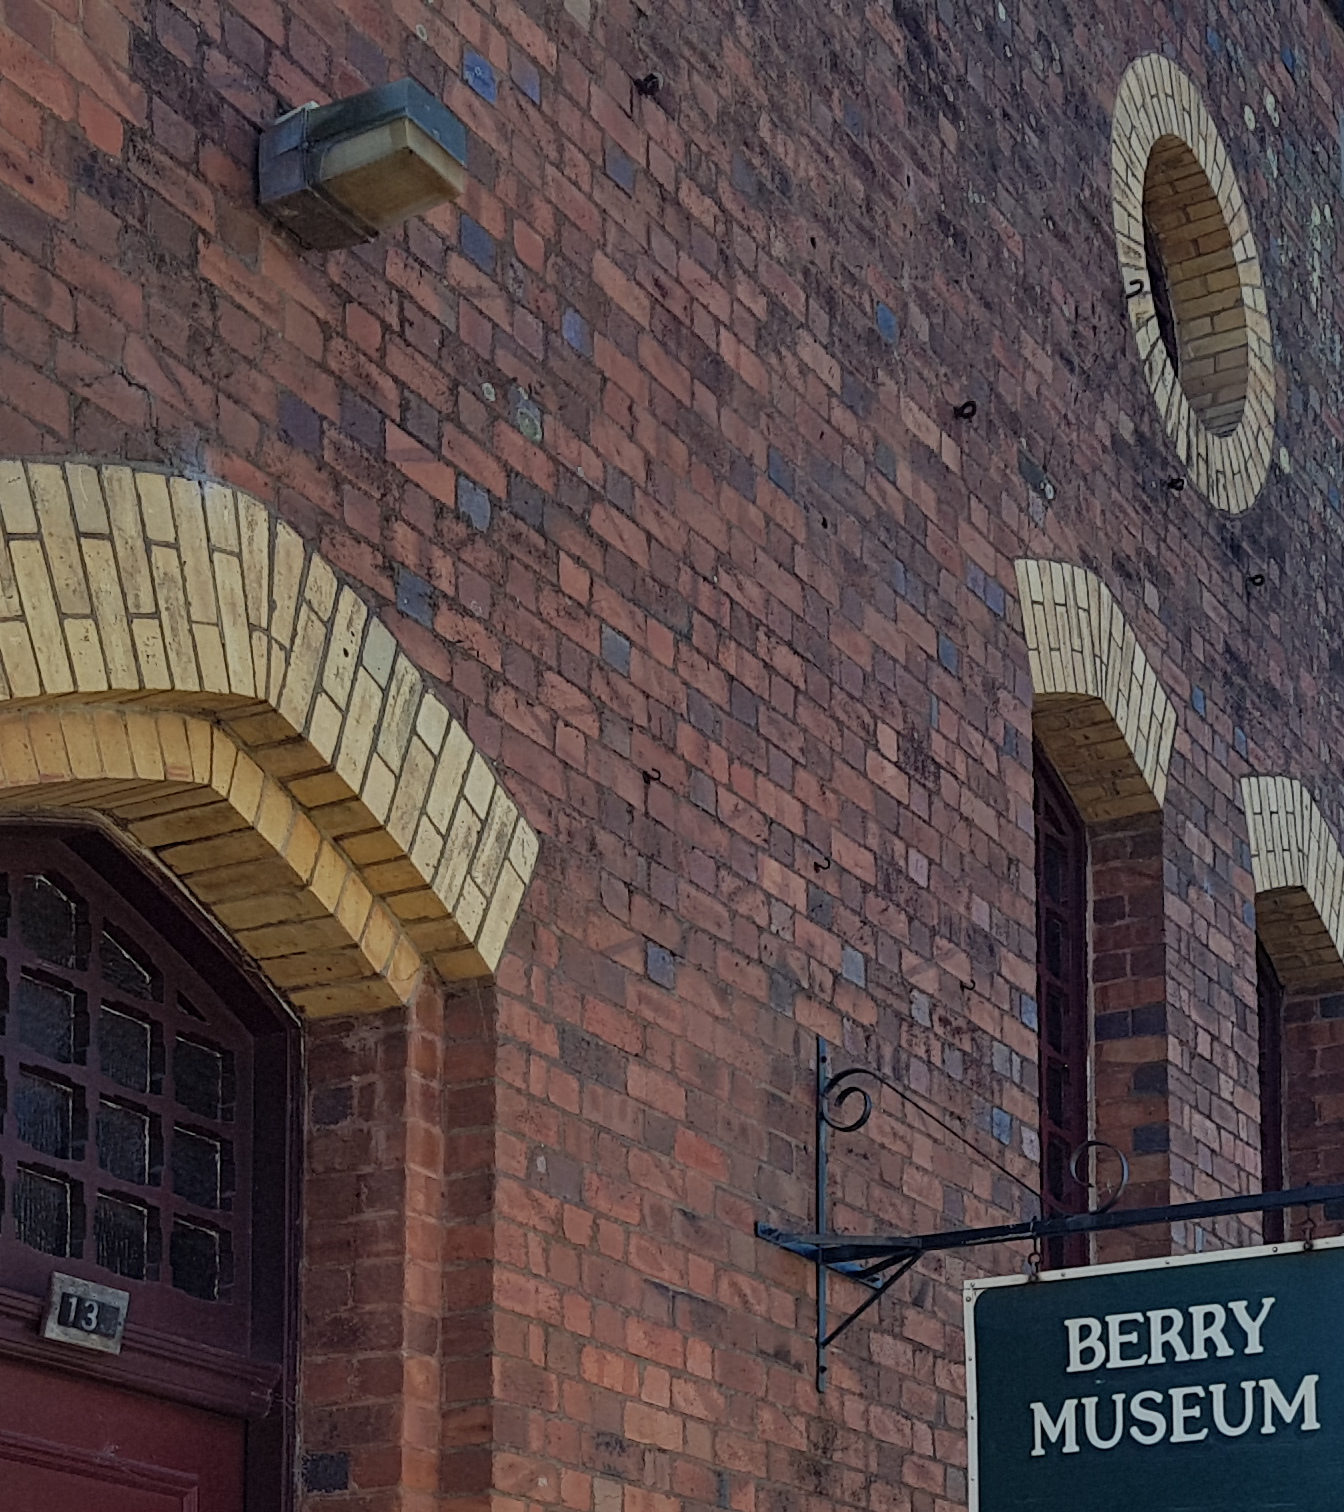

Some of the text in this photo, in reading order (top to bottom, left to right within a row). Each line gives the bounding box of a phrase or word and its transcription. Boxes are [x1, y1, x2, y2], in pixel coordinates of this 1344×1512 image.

[68, 1296, 99, 1331] 13
[1063, 1296, 1276, 1373] BERRY
[1029, 1374, 1321, 1457] MUSEUM
